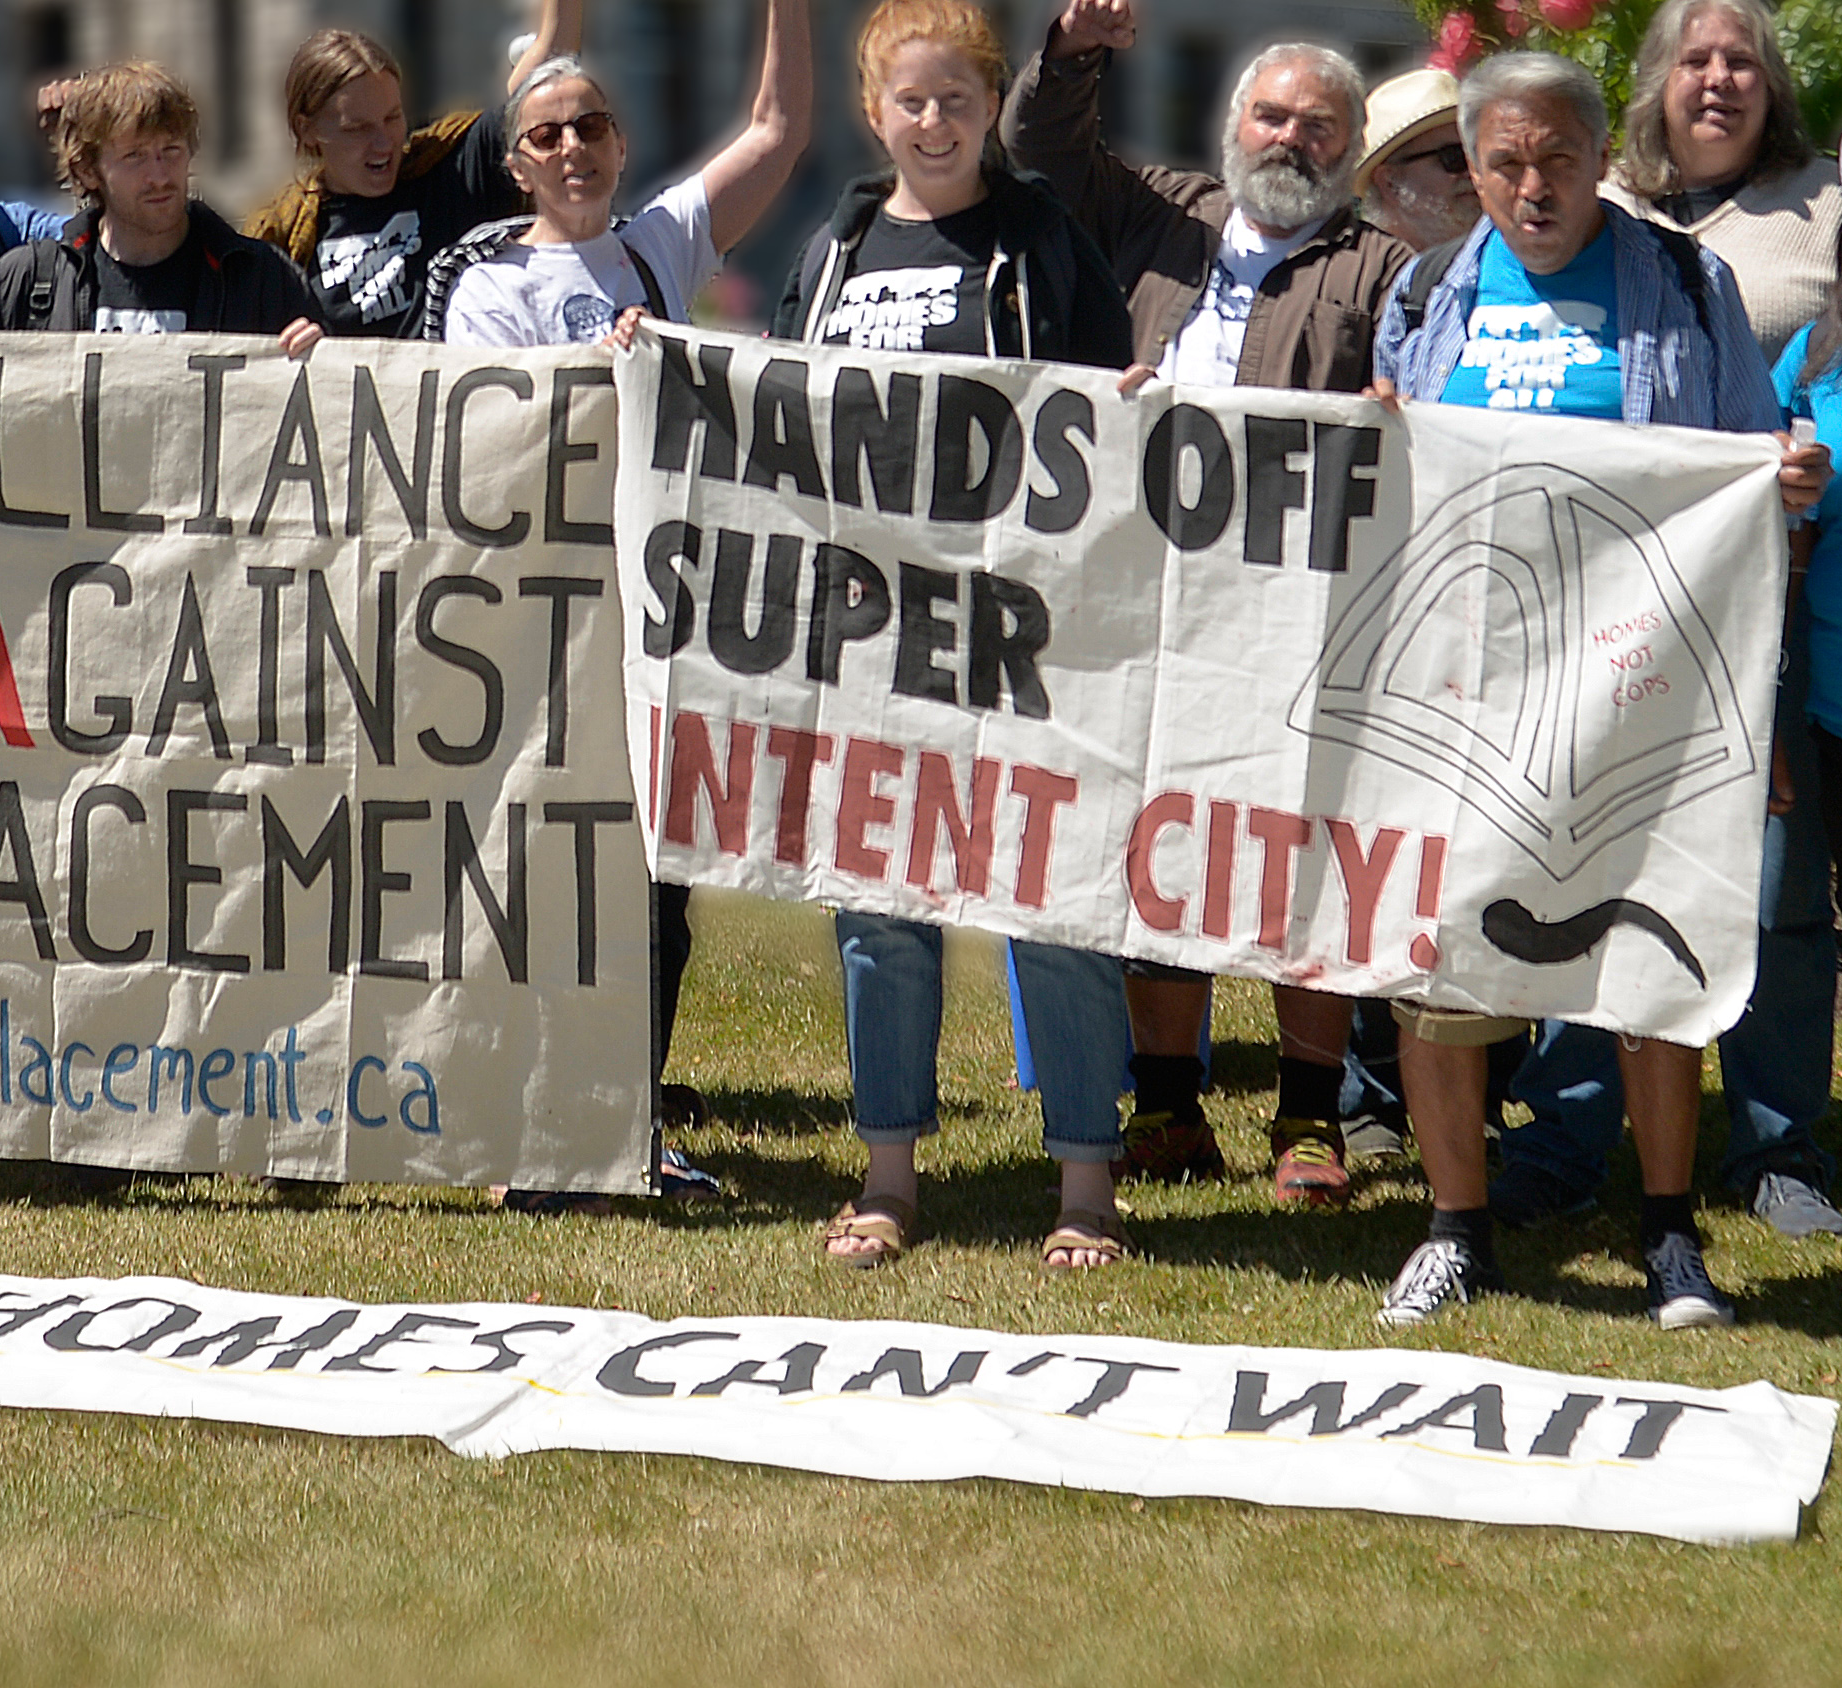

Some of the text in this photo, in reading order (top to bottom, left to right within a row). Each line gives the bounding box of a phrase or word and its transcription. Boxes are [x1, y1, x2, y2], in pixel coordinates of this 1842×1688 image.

[826, 295, 958, 338] HOMES
[1460, 334, 1603, 367] HOMES
[649, 335, 1379, 573] HANDS OFF
[641, 519, 1052, 721] SUPER
[1592, 611, 1662, 647] HOMES
[1609, 644, 1653, 676] NOT
[1612, 673, 1670, 707] COPS
[1124, 789, 1449, 975] CITY!
[595, 1330, 1182, 1419] CAN'T
[1223, 1368, 1729, 1460] WAIT
